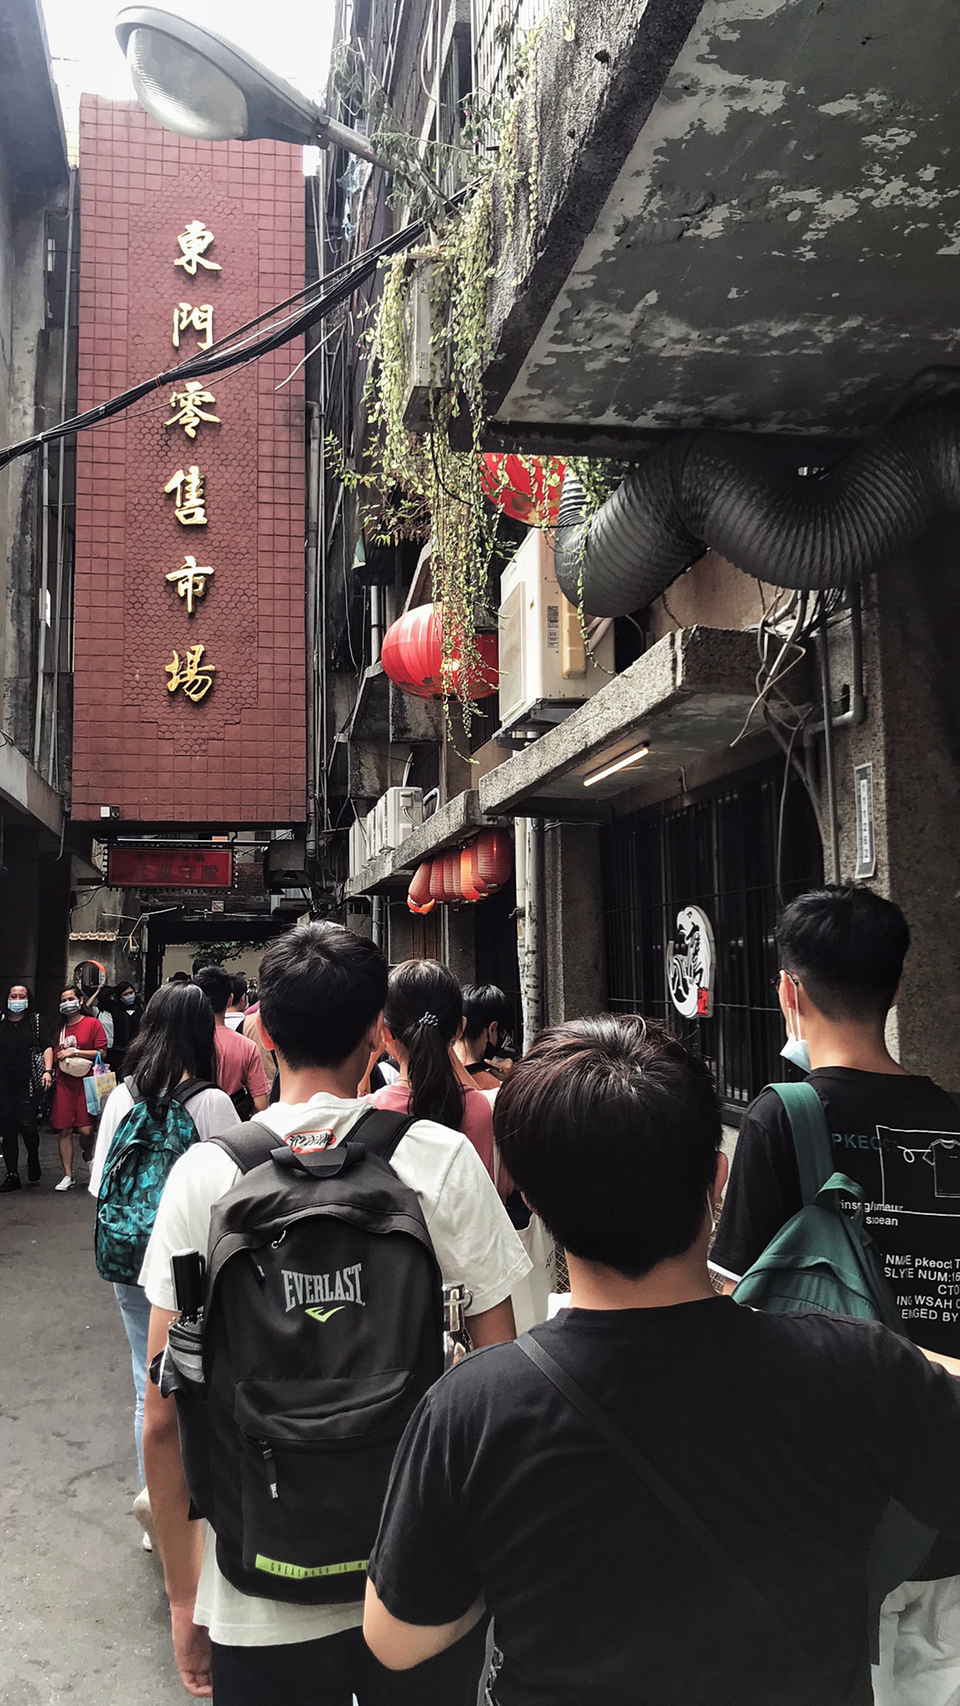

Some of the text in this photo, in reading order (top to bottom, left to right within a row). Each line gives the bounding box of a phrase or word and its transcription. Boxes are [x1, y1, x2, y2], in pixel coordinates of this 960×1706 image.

[163, 220, 222, 703] 東門零售市場
[281, 1263, 362, 1313] EVERLAST
[914, 1294, 953, 1310] WSAH
[942, 1311, 959, 1323] BY
